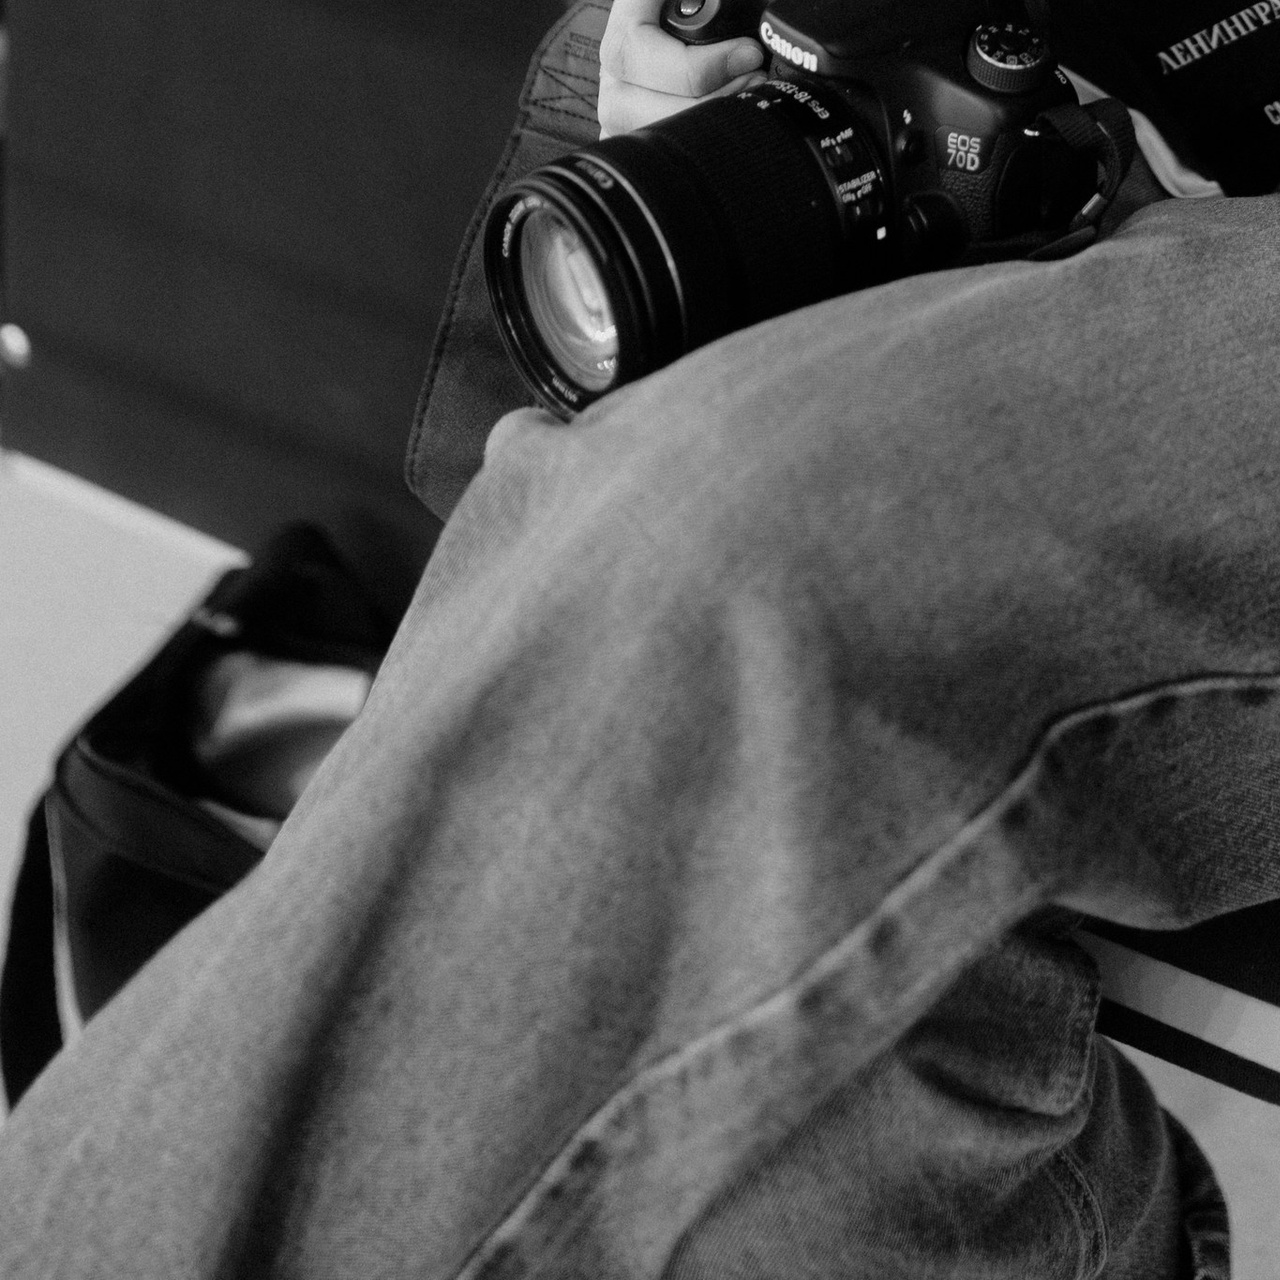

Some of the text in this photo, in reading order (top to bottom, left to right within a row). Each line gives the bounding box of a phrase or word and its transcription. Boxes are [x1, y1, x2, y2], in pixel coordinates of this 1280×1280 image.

[761, 22, 817, 72] Canon
[947, 132, 981, 153] EOS
[947, 148, 980, 171] 70D
